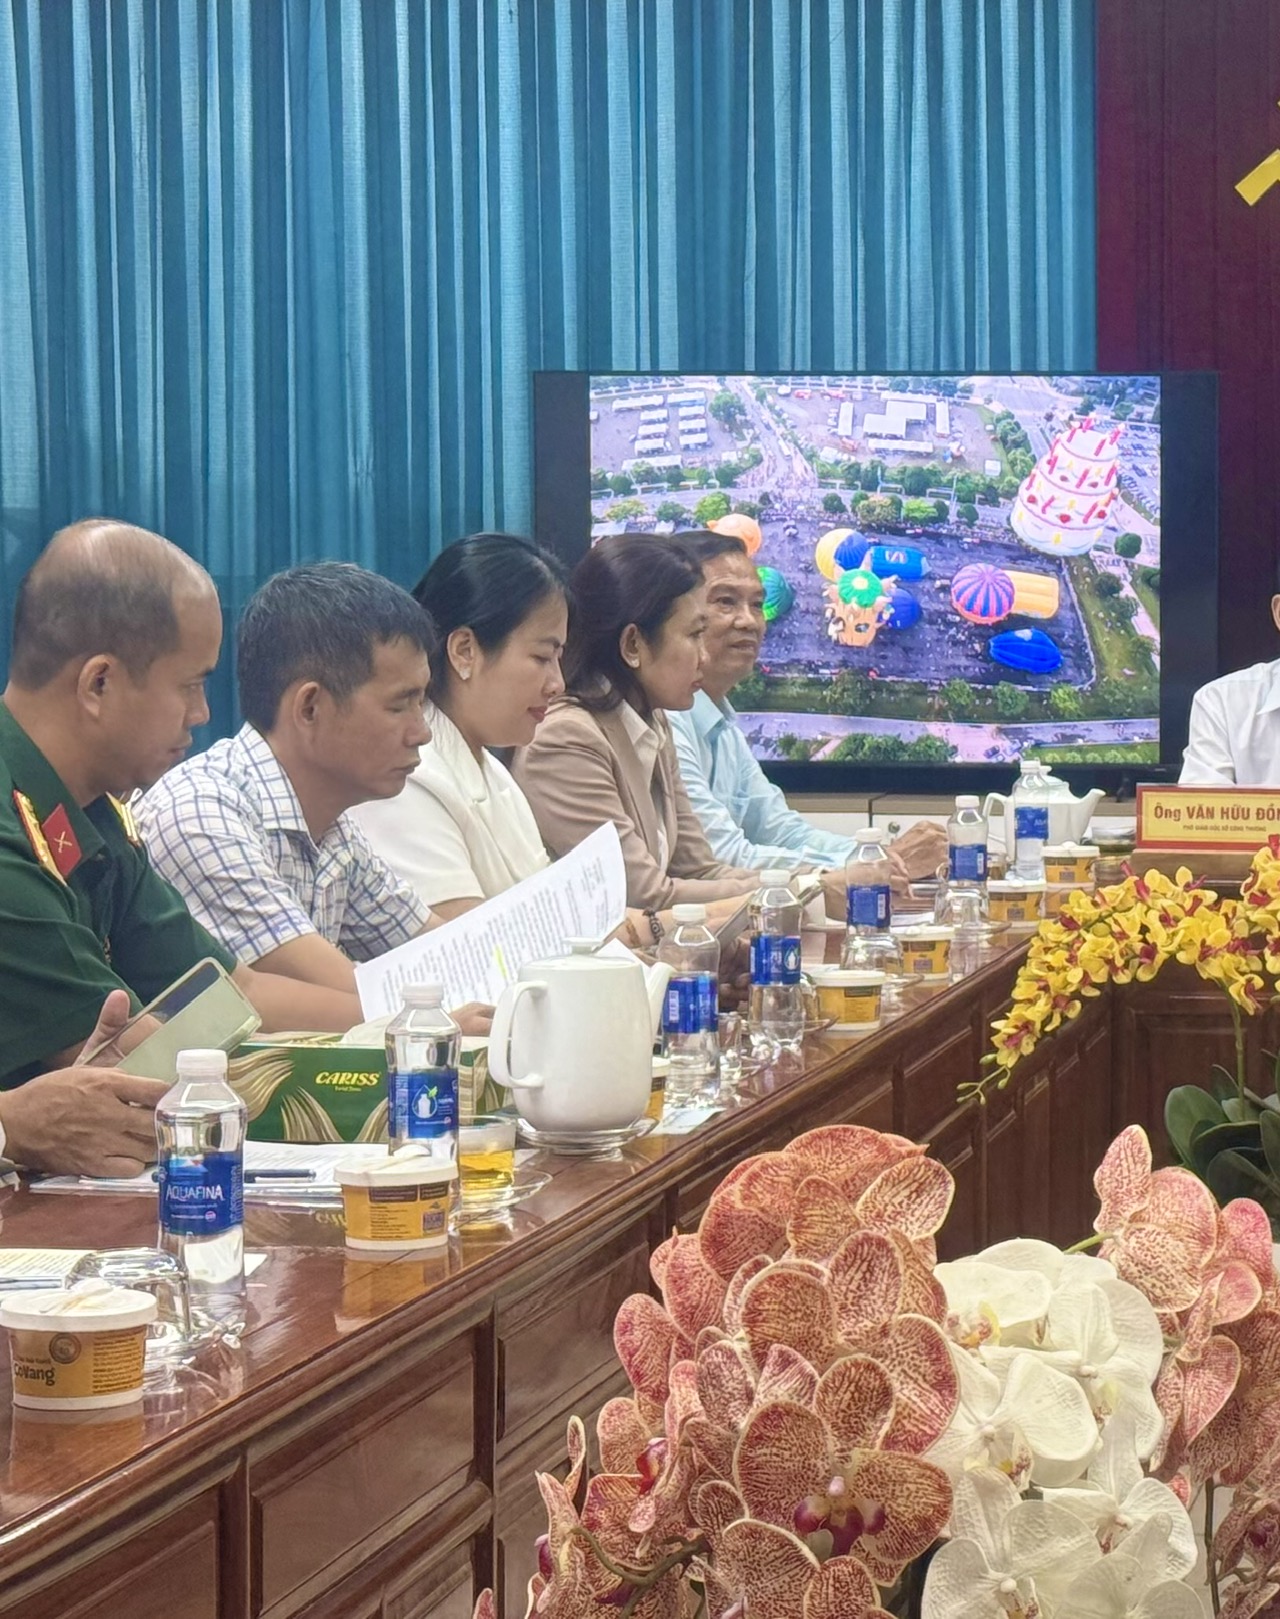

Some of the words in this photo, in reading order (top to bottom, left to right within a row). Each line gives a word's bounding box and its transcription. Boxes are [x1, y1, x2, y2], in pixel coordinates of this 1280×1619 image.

[1154, 802, 1182, 821] Ông
[1186, 803, 1215, 819] VĂN
[315, 1071, 380, 1086] CARISS
[166, 1184, 225, 1202] AQUAFINA
